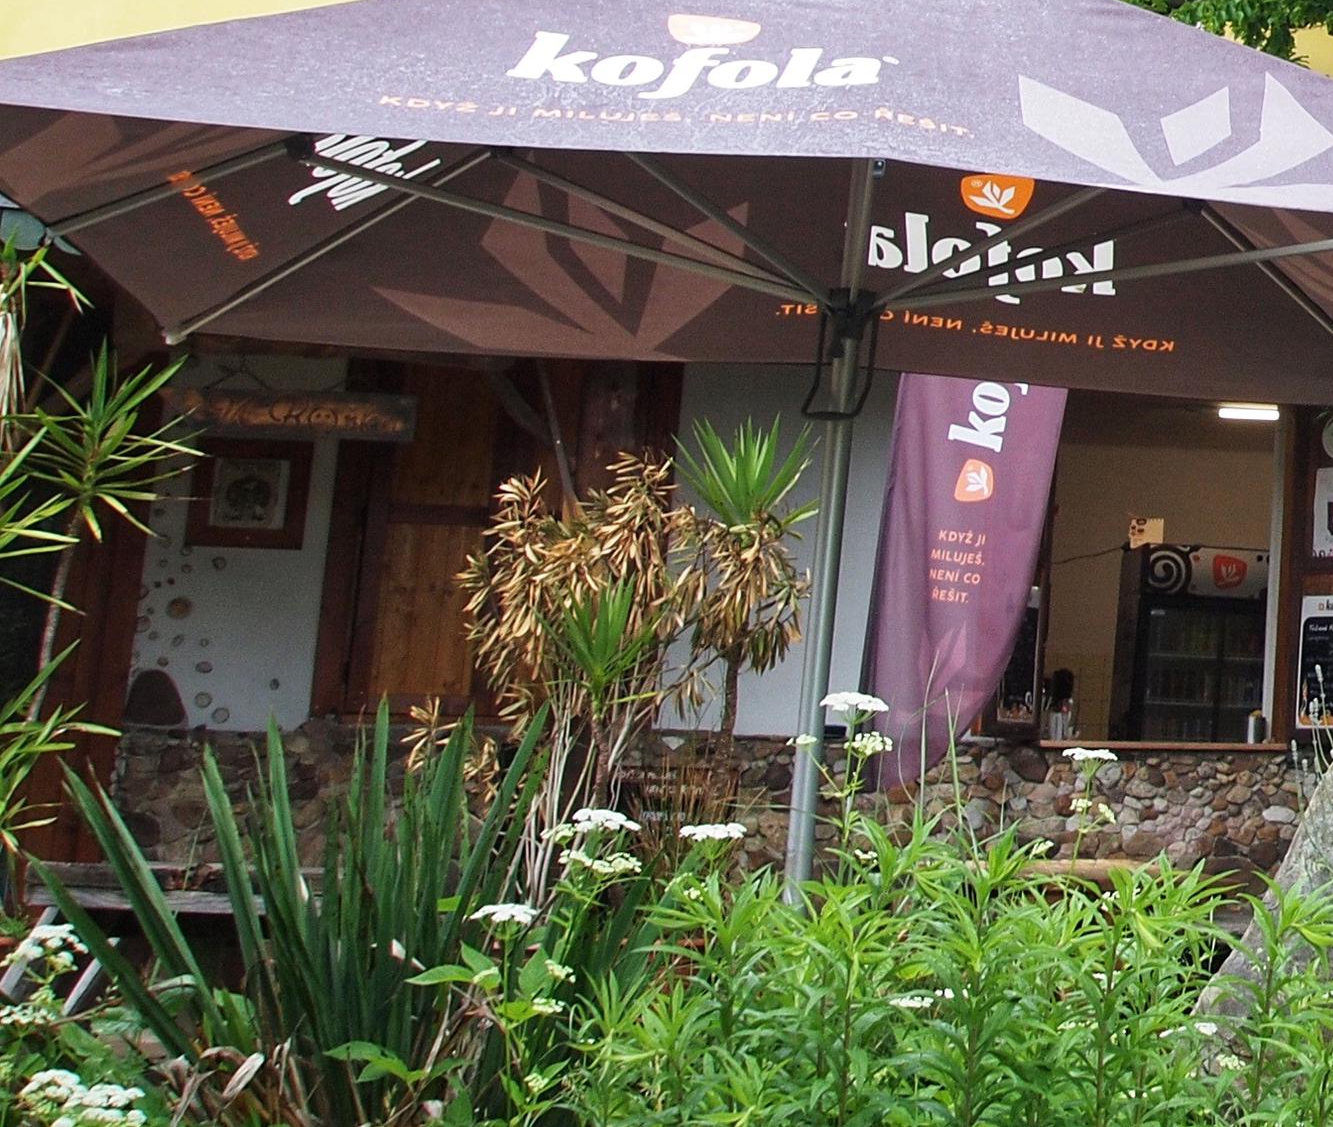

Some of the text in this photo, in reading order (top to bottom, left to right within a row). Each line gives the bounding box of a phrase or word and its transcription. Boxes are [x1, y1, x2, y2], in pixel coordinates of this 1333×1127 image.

[506, 31, 884, 99] kofola
[488, 106, 517, 117] JI
[810, 110, 859, 122] CO
[938, 529, 986, 547] KDYŽ JI
[929, 569, 981, 585] NENÍ CO
[931, 585, 969, 603] ŘEŠIT.
